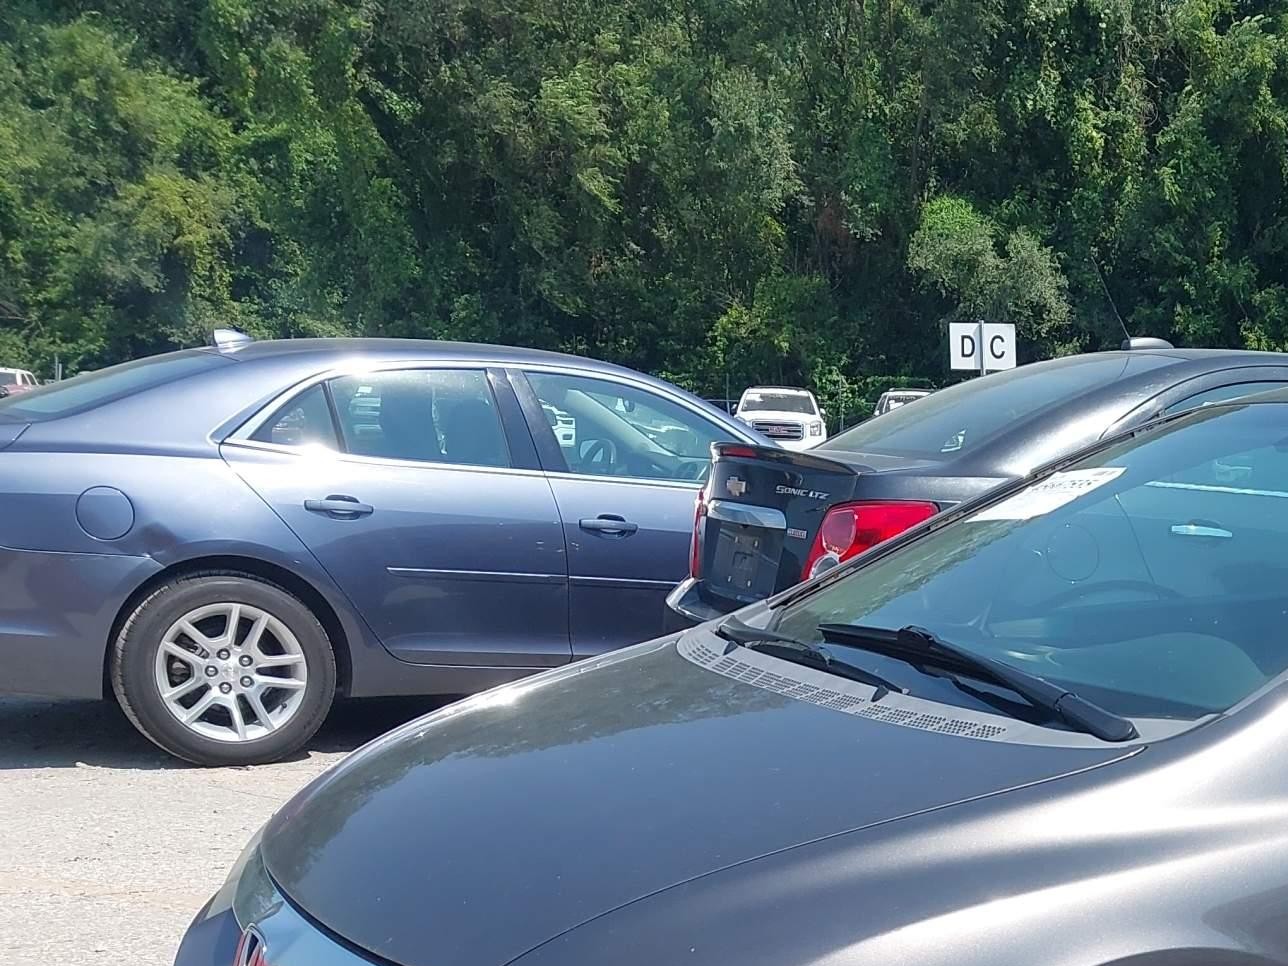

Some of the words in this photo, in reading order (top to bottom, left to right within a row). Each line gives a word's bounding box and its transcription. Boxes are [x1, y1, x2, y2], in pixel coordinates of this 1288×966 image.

[961, 334, 976, 358] D
[989, 334, 1005, 359] C
[775, 485, 808, 497] SONIC
[808, 490, 831, 500] LTZ
